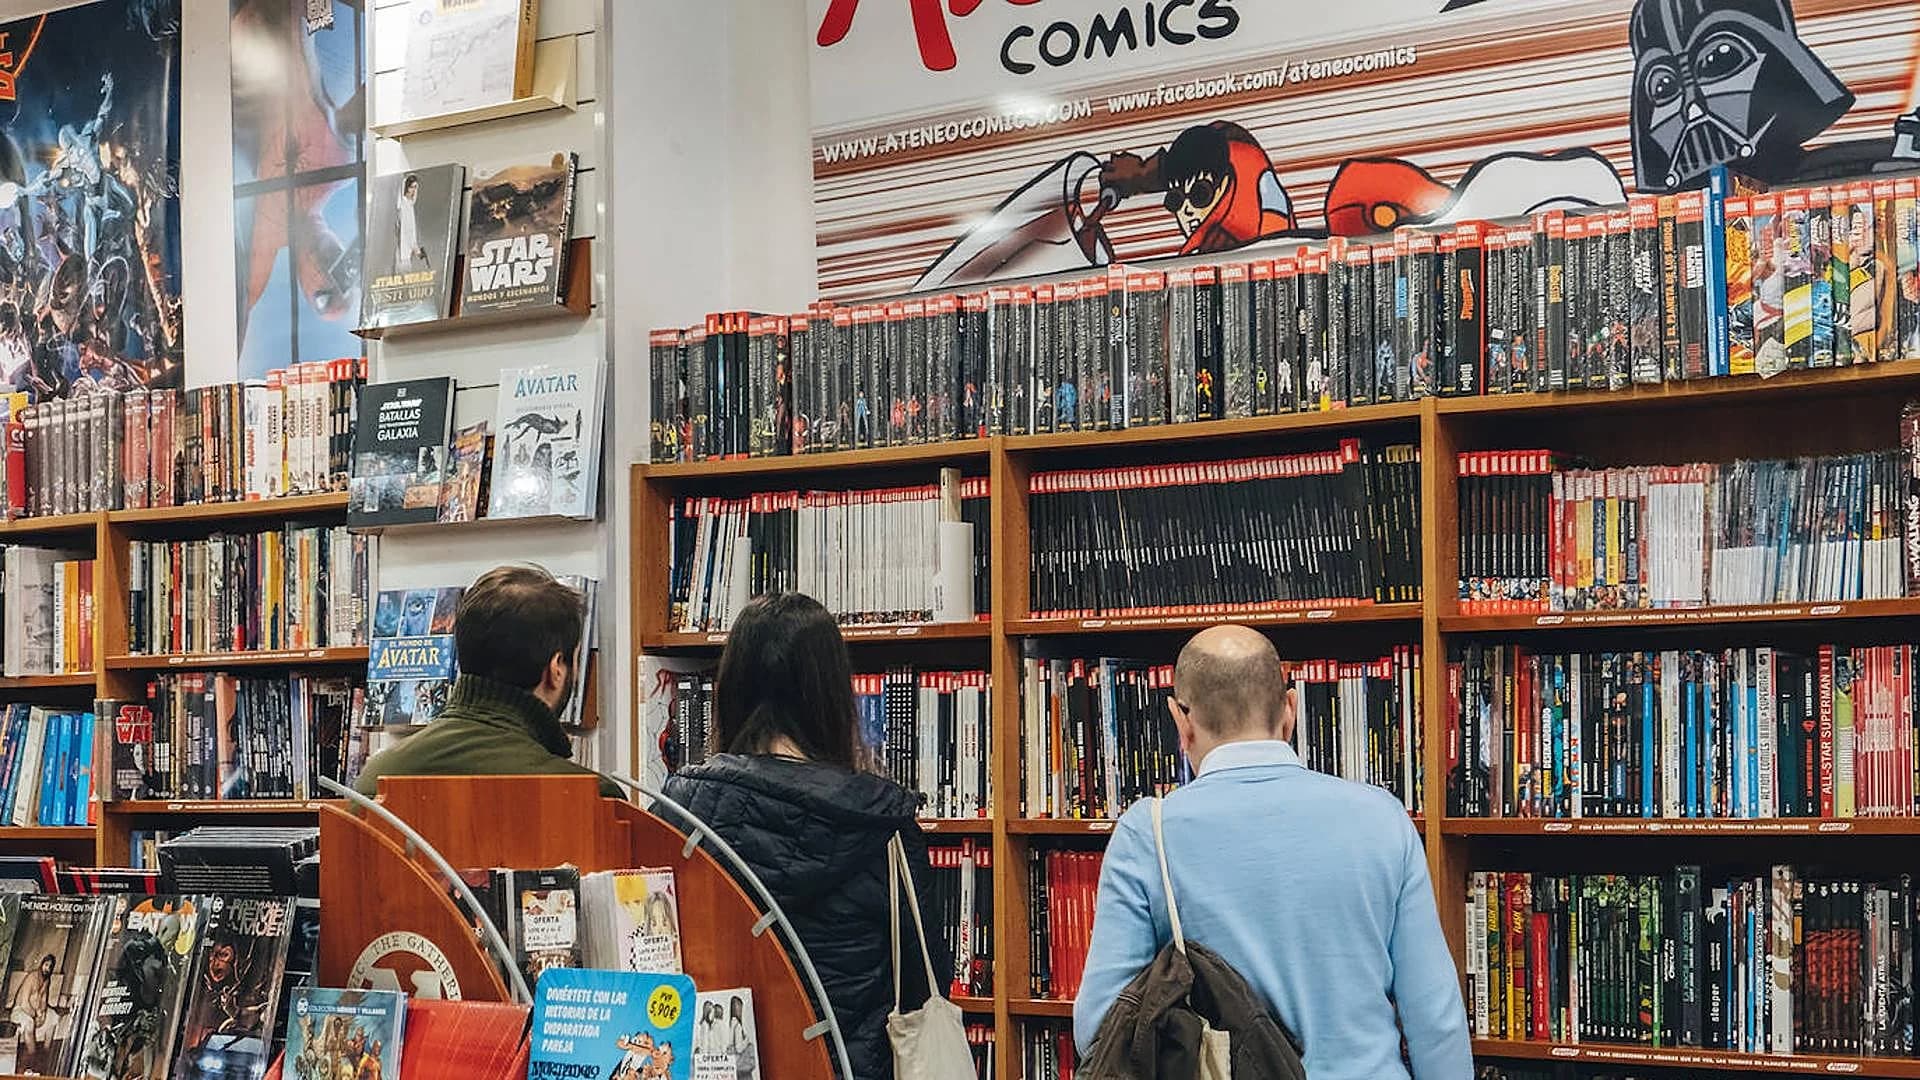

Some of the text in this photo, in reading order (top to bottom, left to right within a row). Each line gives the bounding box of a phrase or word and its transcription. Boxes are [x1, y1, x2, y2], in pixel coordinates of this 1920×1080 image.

[1000, 0, 1240, 74] COMICS
[822, 47, 1417, 163] WWW.ATENEOCOMICS.COM www.facebook.com/ateneocomics
[470, 233, 554, 266] STAR
[470, 257, 553, 292] WARS
[1664, 221, 1676, 336] EL PLANETA DE LOS SIMIOS
[514, 374, 578, 398] AVATAR
[378, 408, 422, 423] BATALLAS
[377, 427, 419, 442] GALAXIA
[377, 647, 441, 669] AVATAR
[116, 704, 153, 725] STA
[116, 724, 153, 744] WA
[1821, 674, 1833, 795] ALL-STAR SUPERMAN
[1759, 743, 1769, 770] COMICS
[127, 911, 198, 938] BATN
[534, 916, 559, 924] OFERTA
[1488, 908, 1497, 931] FLASH
[1512, 910, 1522, 933] FLASH
[643, 936, 668, 945] OFERTA
[370, 934, 400, 955] THE
[407, 935, 459, 1000] GATHERI
[546, 986, 628, 1005] DIVIÉRTETE CON LAS
[1477, 995, 1486, 1018] FLASH
[1710, 984, 1722, 1023] sleeper
[1878, 983, 1886, 1017] CUENTA
[545, 1004, 612, 1021] HISTORIAS DE LA
[543, 1022, 601, 1038] DISPARATADA
[1878, 1019, 1886, 1031] LA
[541, 1038, 574, 1054] PAREJA
[703, 1055, 728, 1063] OFERTA
